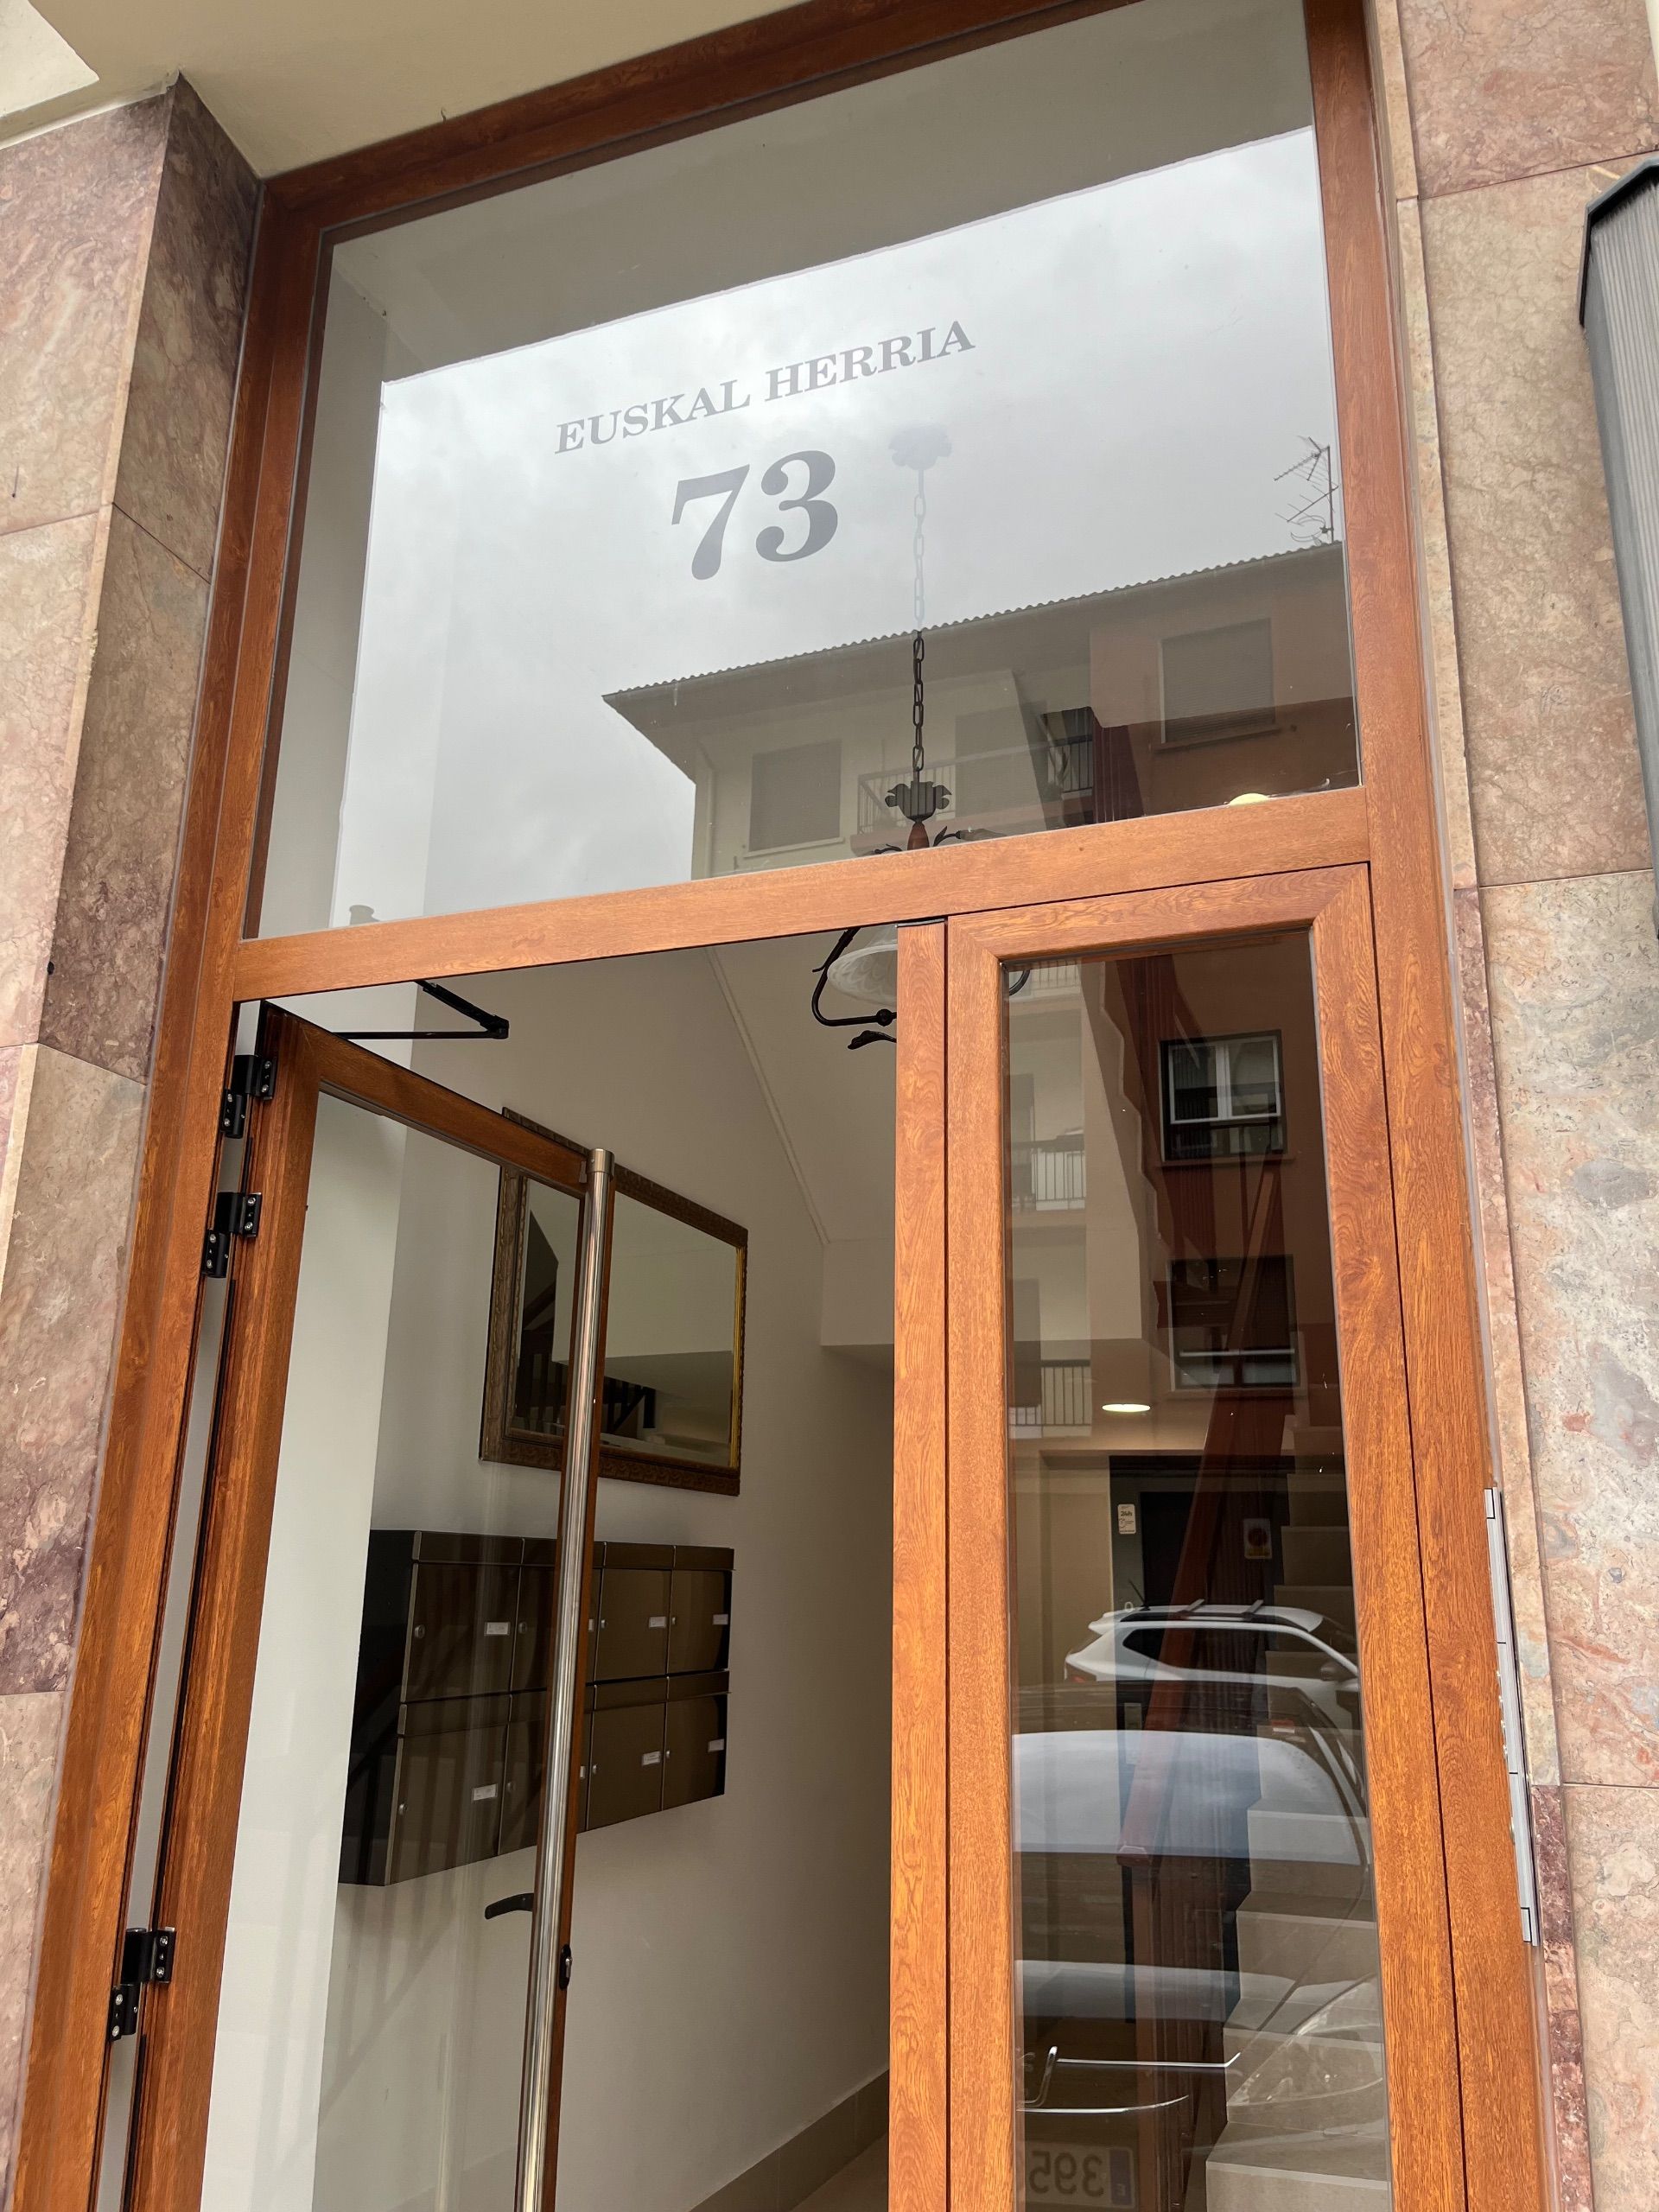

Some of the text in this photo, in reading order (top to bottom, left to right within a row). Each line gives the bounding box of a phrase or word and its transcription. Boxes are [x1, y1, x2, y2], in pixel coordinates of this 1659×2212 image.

[554, 321, 976, 454] EUSKAL HERRIA
[671, 449, 839, 581] 73
